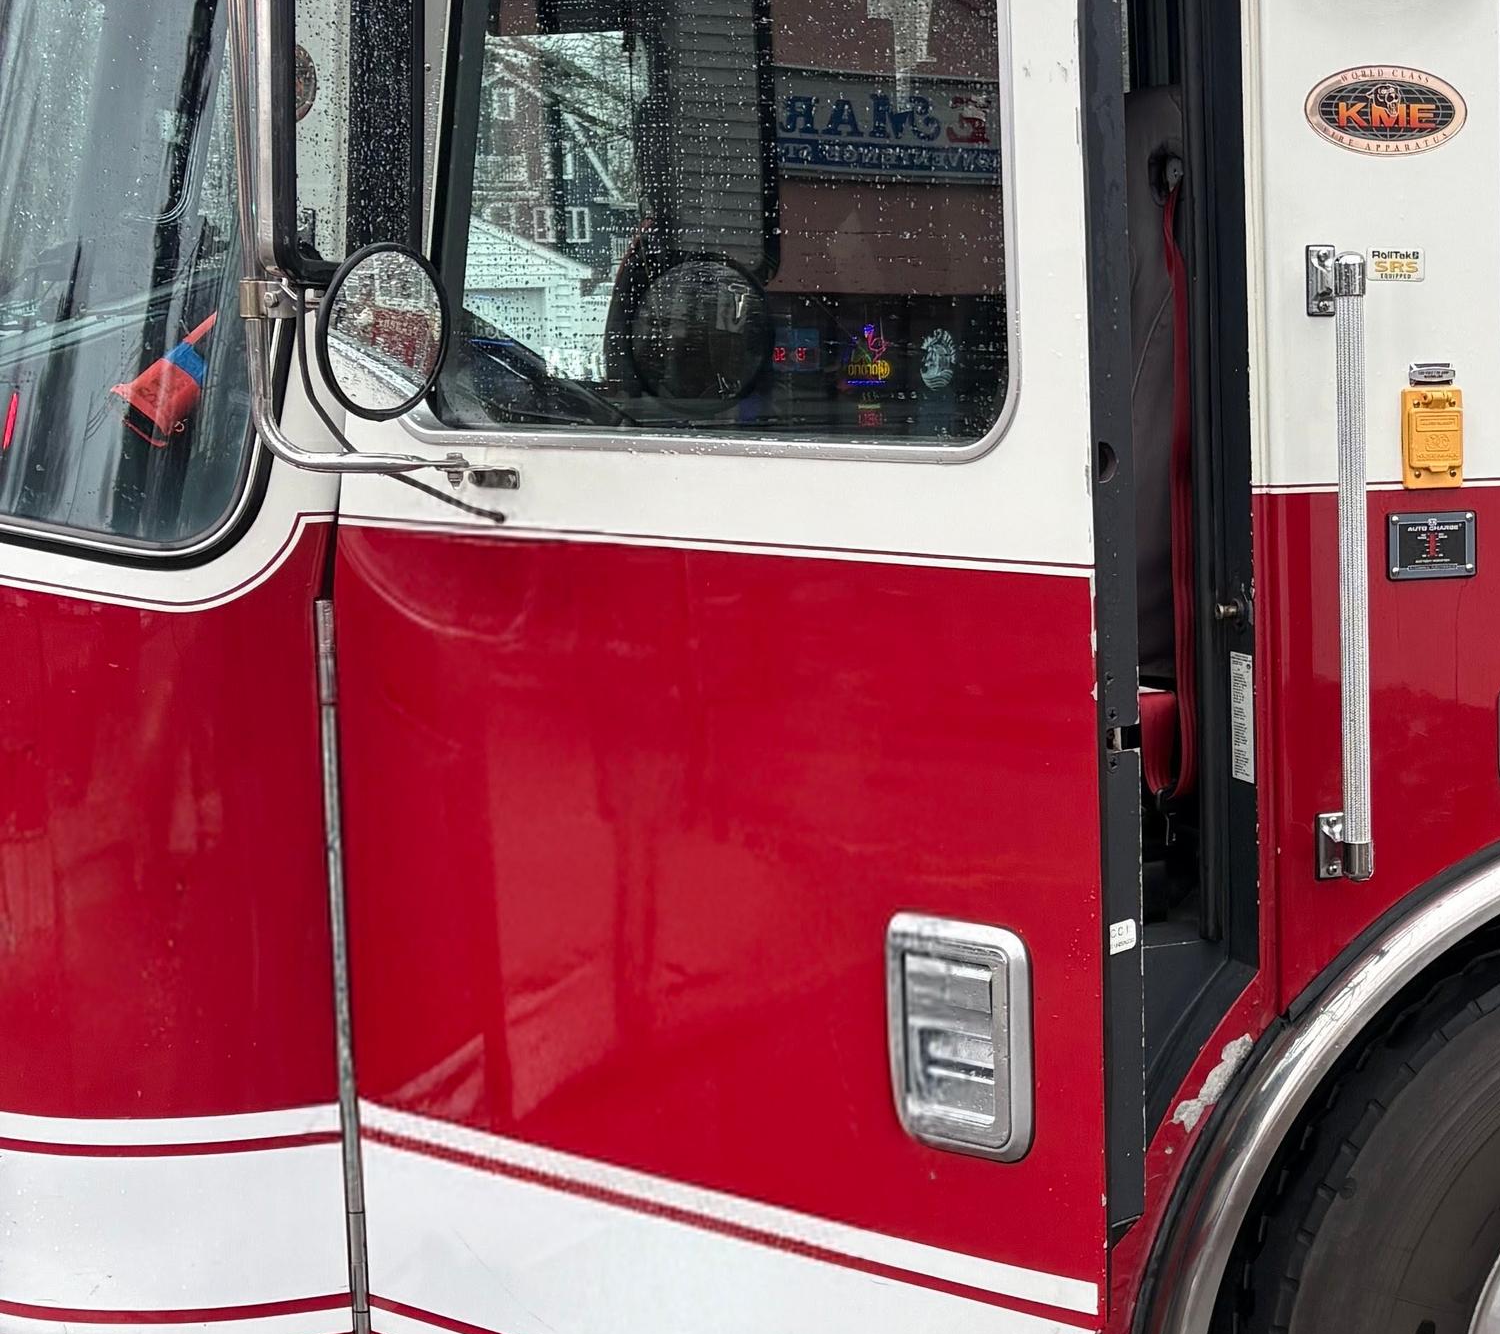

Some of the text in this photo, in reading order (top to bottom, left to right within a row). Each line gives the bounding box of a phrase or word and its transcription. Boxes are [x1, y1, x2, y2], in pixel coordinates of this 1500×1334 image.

[1340, 69, 1430, 84] WORLD CLASS
[1337, 101, 1437, 129] KME
[1322, 126, 1449, 152] FIRE APPARATUS
[1375, 261, 1418, 273] SRS
